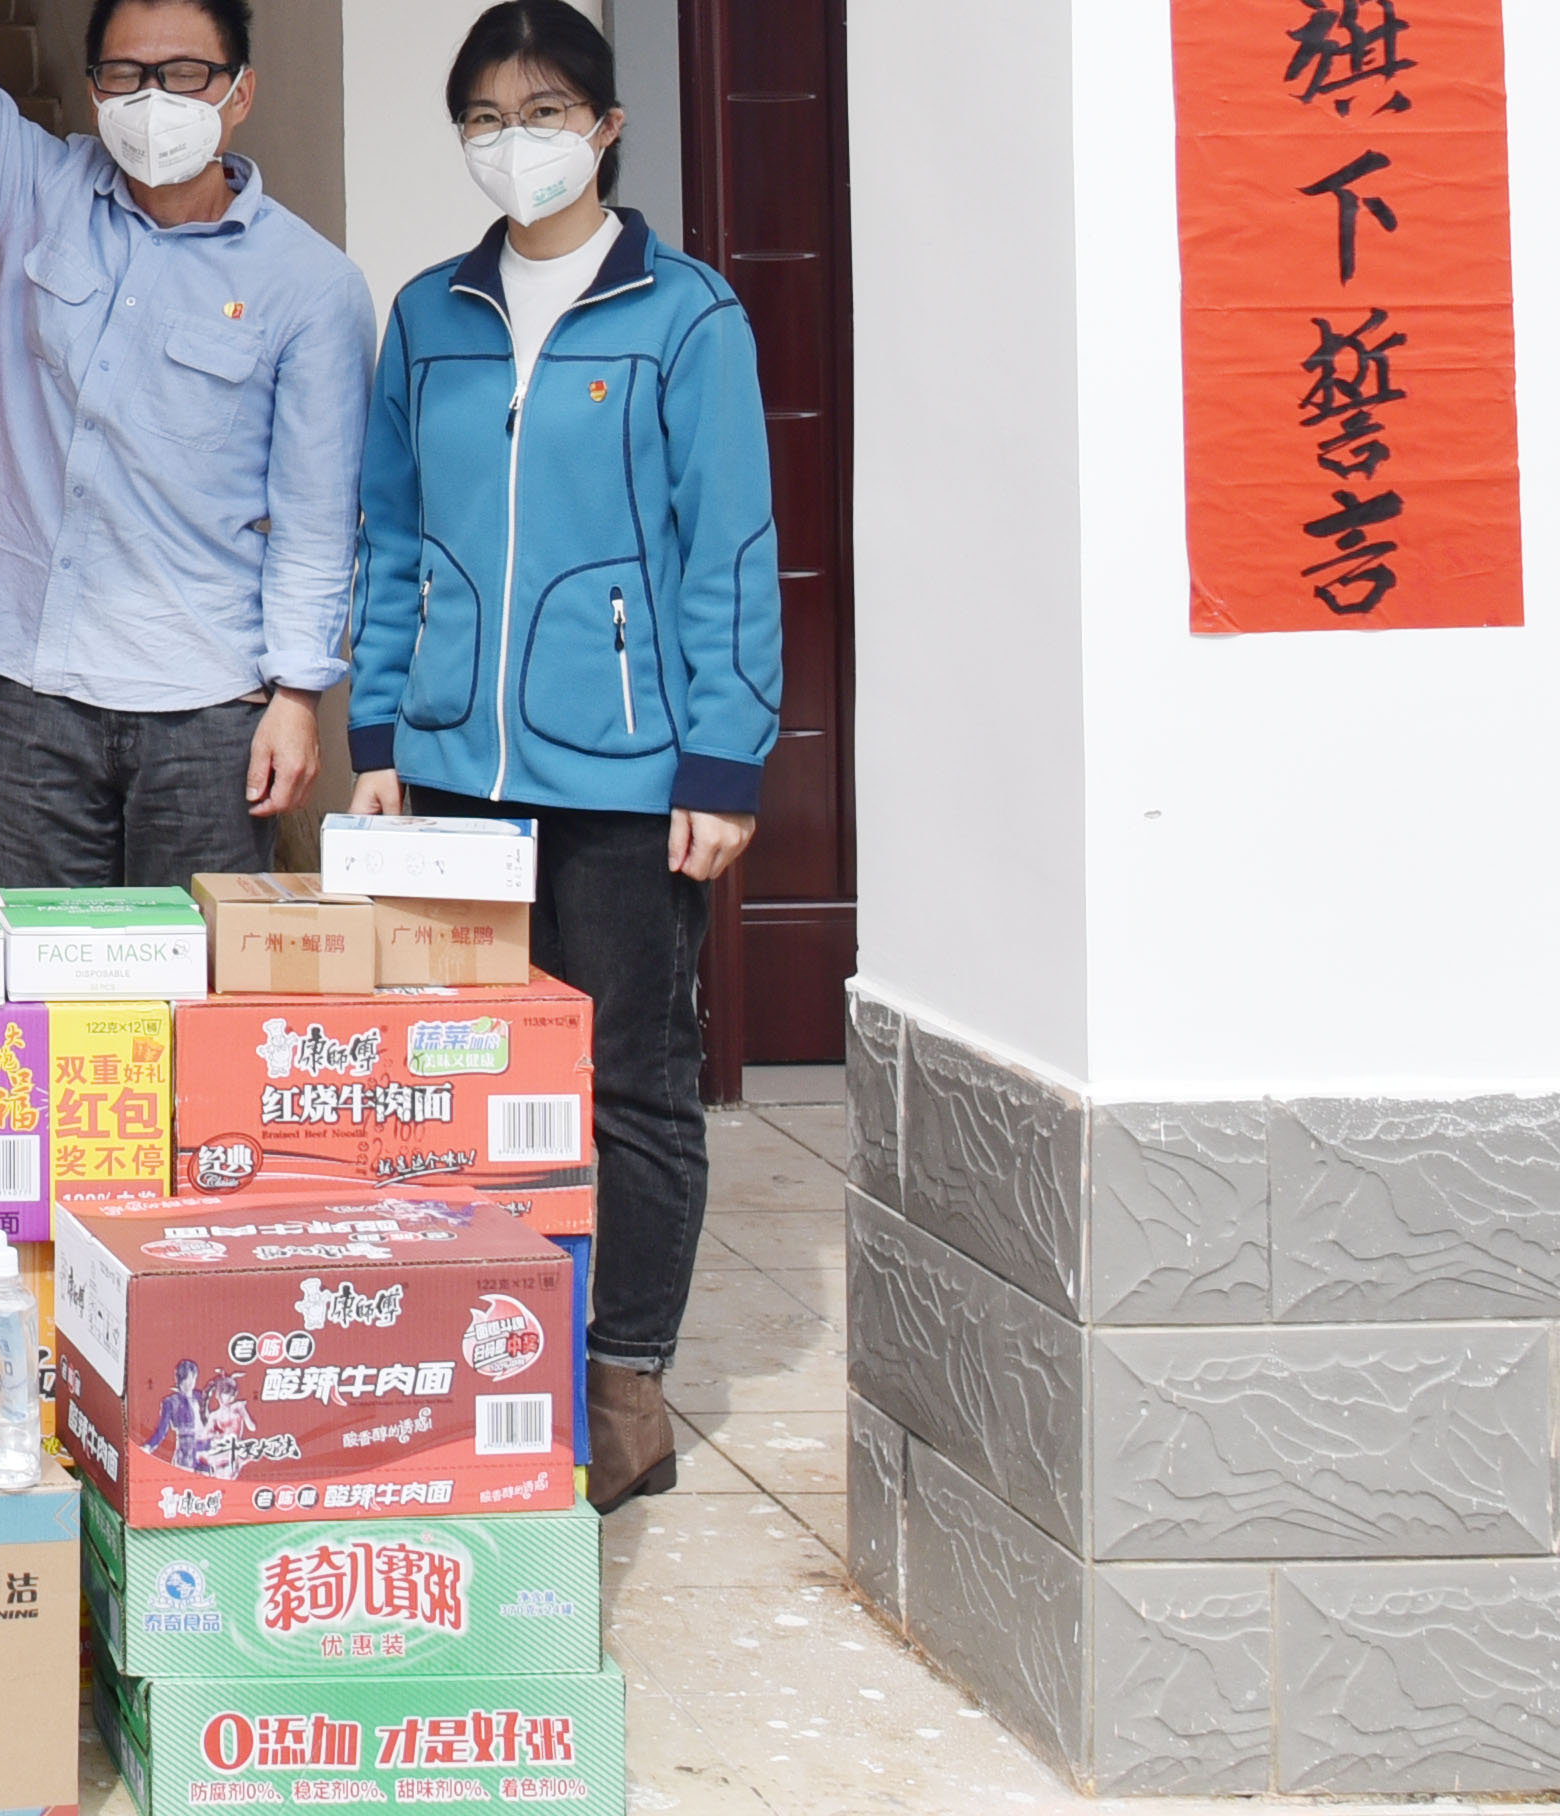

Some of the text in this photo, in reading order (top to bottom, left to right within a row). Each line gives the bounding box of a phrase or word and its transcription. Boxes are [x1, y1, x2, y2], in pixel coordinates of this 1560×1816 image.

[37, 943, 167, 963] FACE MASK
[75, 969, 131, 979] DISPOSABLE
[55, 1088, 164, 1140] 红包
[261, 1083, 453, 1126] 红烧牛肉面
[56, 1146, 165, 1177] 奖不停
[198, 1144, 254, 1176] 经典
[234, 1335, 312, 1362] 老陈醋
[261, 1361, 457, 1404] 酸辣牛肉面
[323, 1480, 455, 1511] 酸辣牛肉面
[142, 1613, 222, 1633] 泰奇食品
[320, 1633, 406, 1658] 优惠装
[377, 1709, 577, 1768] 才是好粥
